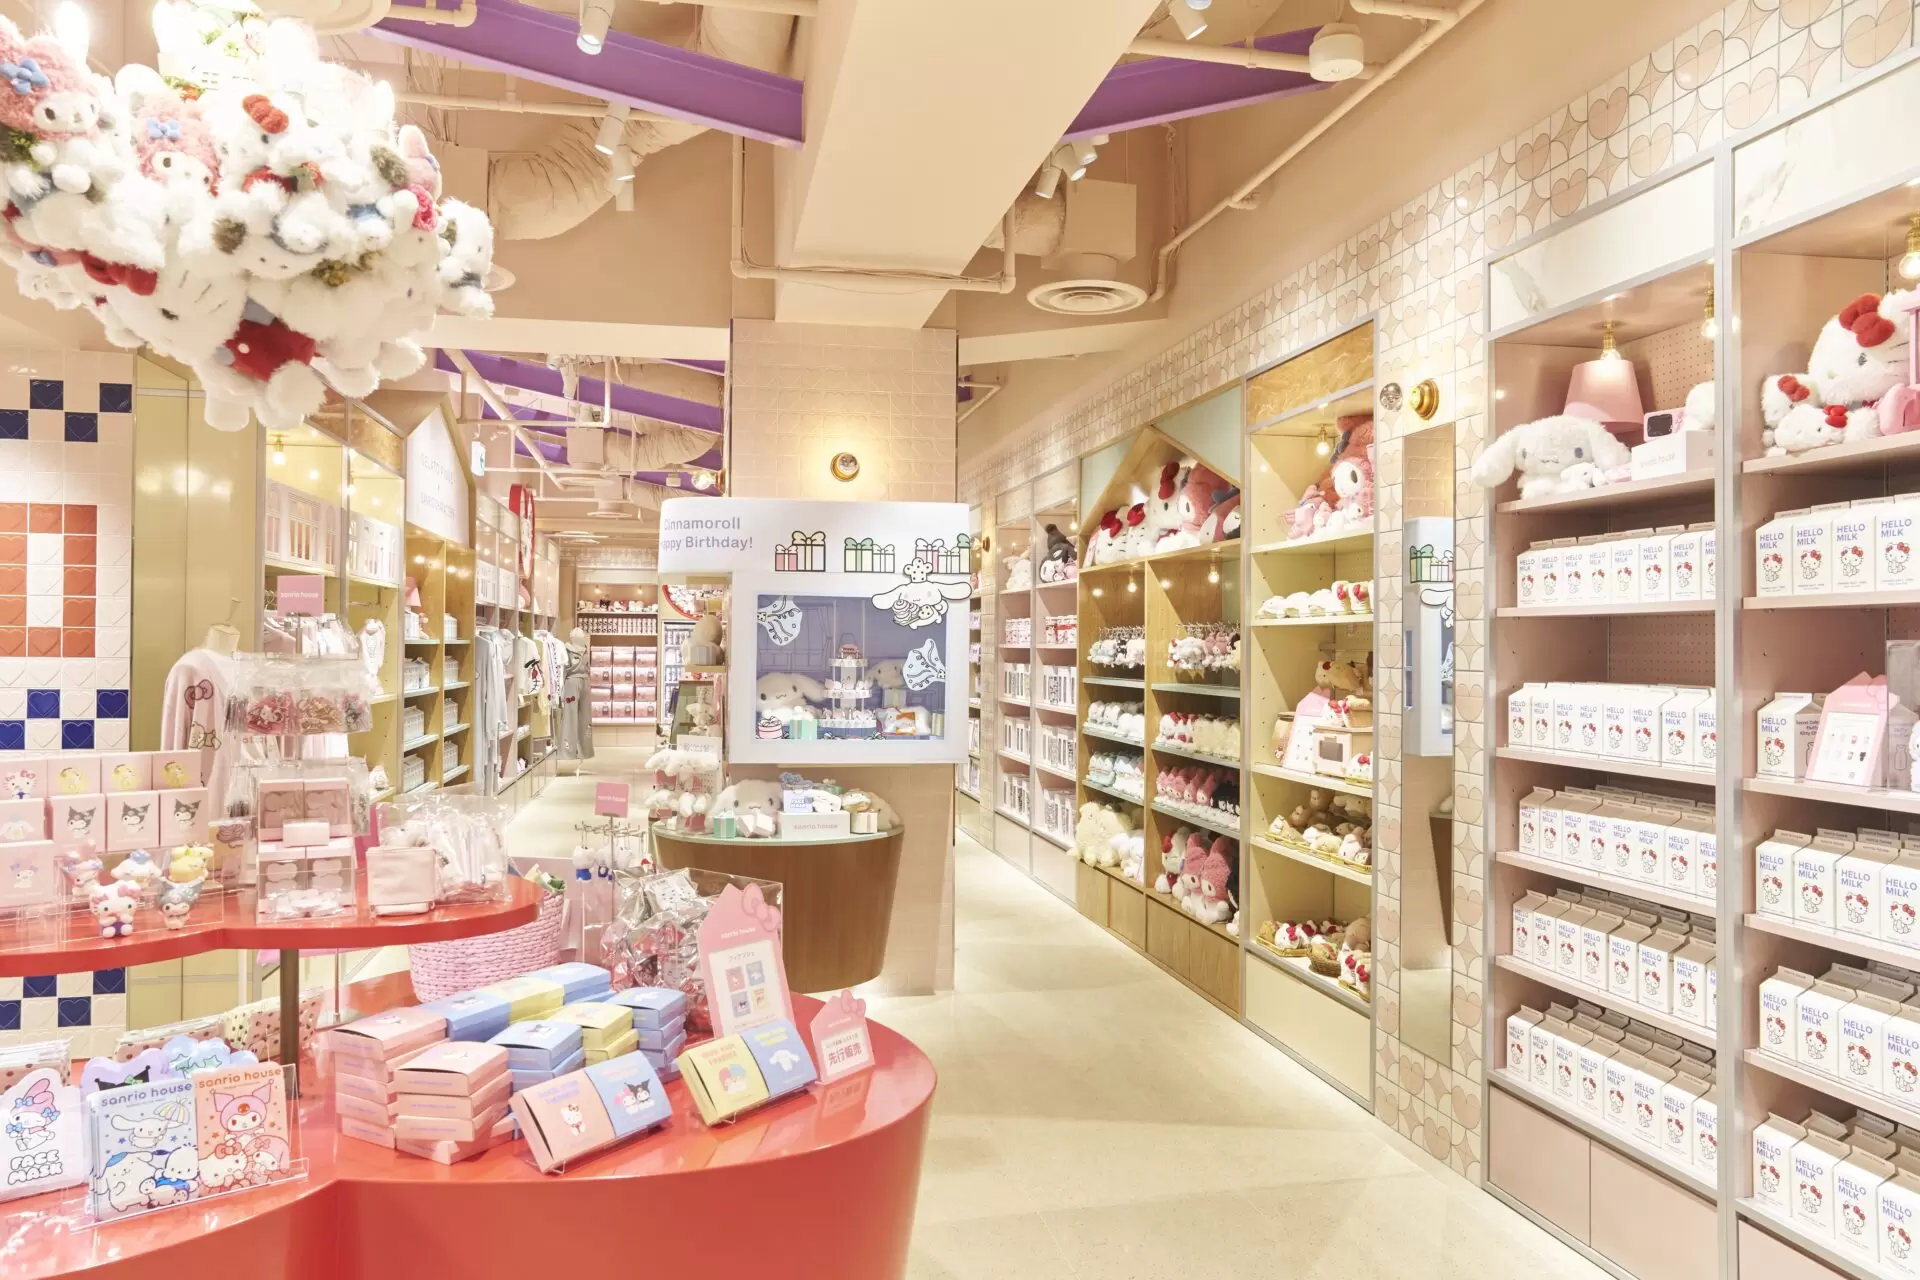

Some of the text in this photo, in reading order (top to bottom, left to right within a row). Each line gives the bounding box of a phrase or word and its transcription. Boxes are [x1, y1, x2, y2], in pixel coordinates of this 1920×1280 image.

[1836, 523, 1866, 534] HELLO
[1881, 518, 1912, 529] HELLO
[1760, 532, 1784, 542] HELLO
[1797, 528, 1824, 538] HELLO
[1836, 533, 1858, 542] MILK
[1881, 528, 1904, 539] MILK
[662, 536, 753, 551] appy Birthday!
[1760, 541, 1778, 550] MILK
[1797, 537, 1816, 546] MILK
[1674, 550, 1688, 558] MILK
[1665, 710, 1686, 718] HELLO
[1761, 716, 1787, 726] HELLO
[1761, 725, 1780, 733] MILK
[1565, 815, 1582, 823] HELLO
[1613, 824, 1631, 833] HELLO
[1640, 830, 1659, 839] HELLO
[1668, 836, 1690, 845] HELLO
[1668, 842, 1684, 851] MILK
[1760, 854, 1784, 866] HELLO
[1760, 862, 1778, 872] MILK
[1798, 861, 1825, 873] HELLO
[1798, 869, 1819, 880] MILK
[1841, 869, 1870, 882] HELLO
[1841, 878, 1863, 889] MILK
[1885, 878, 1918, 891] HELLO
[1885, 887, 1909, 898] MILK
[1558, 930, 1570, 938] MILK
[1559, 924, 1576, 934] HELLO
[1584, 932, 1600, 942] HELLO
[1584, 939, 1596, 947] MILK
[1612, 942, 1630, 952] HELLO
[1612, 948, 1626, 957] MILK
[1642, 950, 1662, 962] HELLO
[1642, 957, 1657, 967] MILK
[1677, 961, 1698, 972] HELLO
[1677, 968, 1692, 979] MILK
[1763, 992, 1787, 1006] HELLO
[1763, 1000, 1781, 1013] MILK
[1801, 1005, 1829, 1020] HELLO
[1801, 1013, 1822, 1026] MILK
[1510, 1026, 1524, 1036] HELLO
[1843, 1018, 1873, 1034] HELLO
[1843, 1027, 1865, 1041] MILK
[1532, 1041, 1544, 1050] MILK
[1533, 1035, 1548, 1046] HELLO
[1887, 1033, 1920, 1050] HELLO
[1556, 1045, 1573, 1057] HELLO
[1887, 1042, 1912, 1056] MILK
[1556, 1052, 1568, 1061] MILK
[1580, 1056, 1598, 1069] HELLO
[1580, 1063, 1593, 1073] MILK
[199, 1068, 282, 1088] sanrio house
[1607, 1068, 1626, 1082] HELLO
[1607, 1076, 1621, 1086] MILK
[1634, 1081, 1655, 1095] HELLO
[101, 1090, 146, 1107] sanrio
[151, 1082, 193, 1097] house
[1634, 1088, 1649, 1100] MILK
[1664, 1096, 1685, 1110] HELLO
[1664, 1102, 1680, 1114] MILK
[1697, 1118, 1713, 1130] MILK
[1756, 1138, 1782, 1156] HELLO
[10, 1149, 60, 1170] FACE
[1756, 1148, 1775, 1161] MILK
[1795, 1157, 1824, 1176] HELLO
[8, 1161, 63, 1185] MASK
[1795, 1166, 1816, 1181] MILK
[1838, 1175, 1867, 1196] HELLO
[1838, 1185, 1860, 1201] MILK
[1882, 1196, 1912, 1218] HELLO
[1882, 1206, 1905, 1224] MILK
